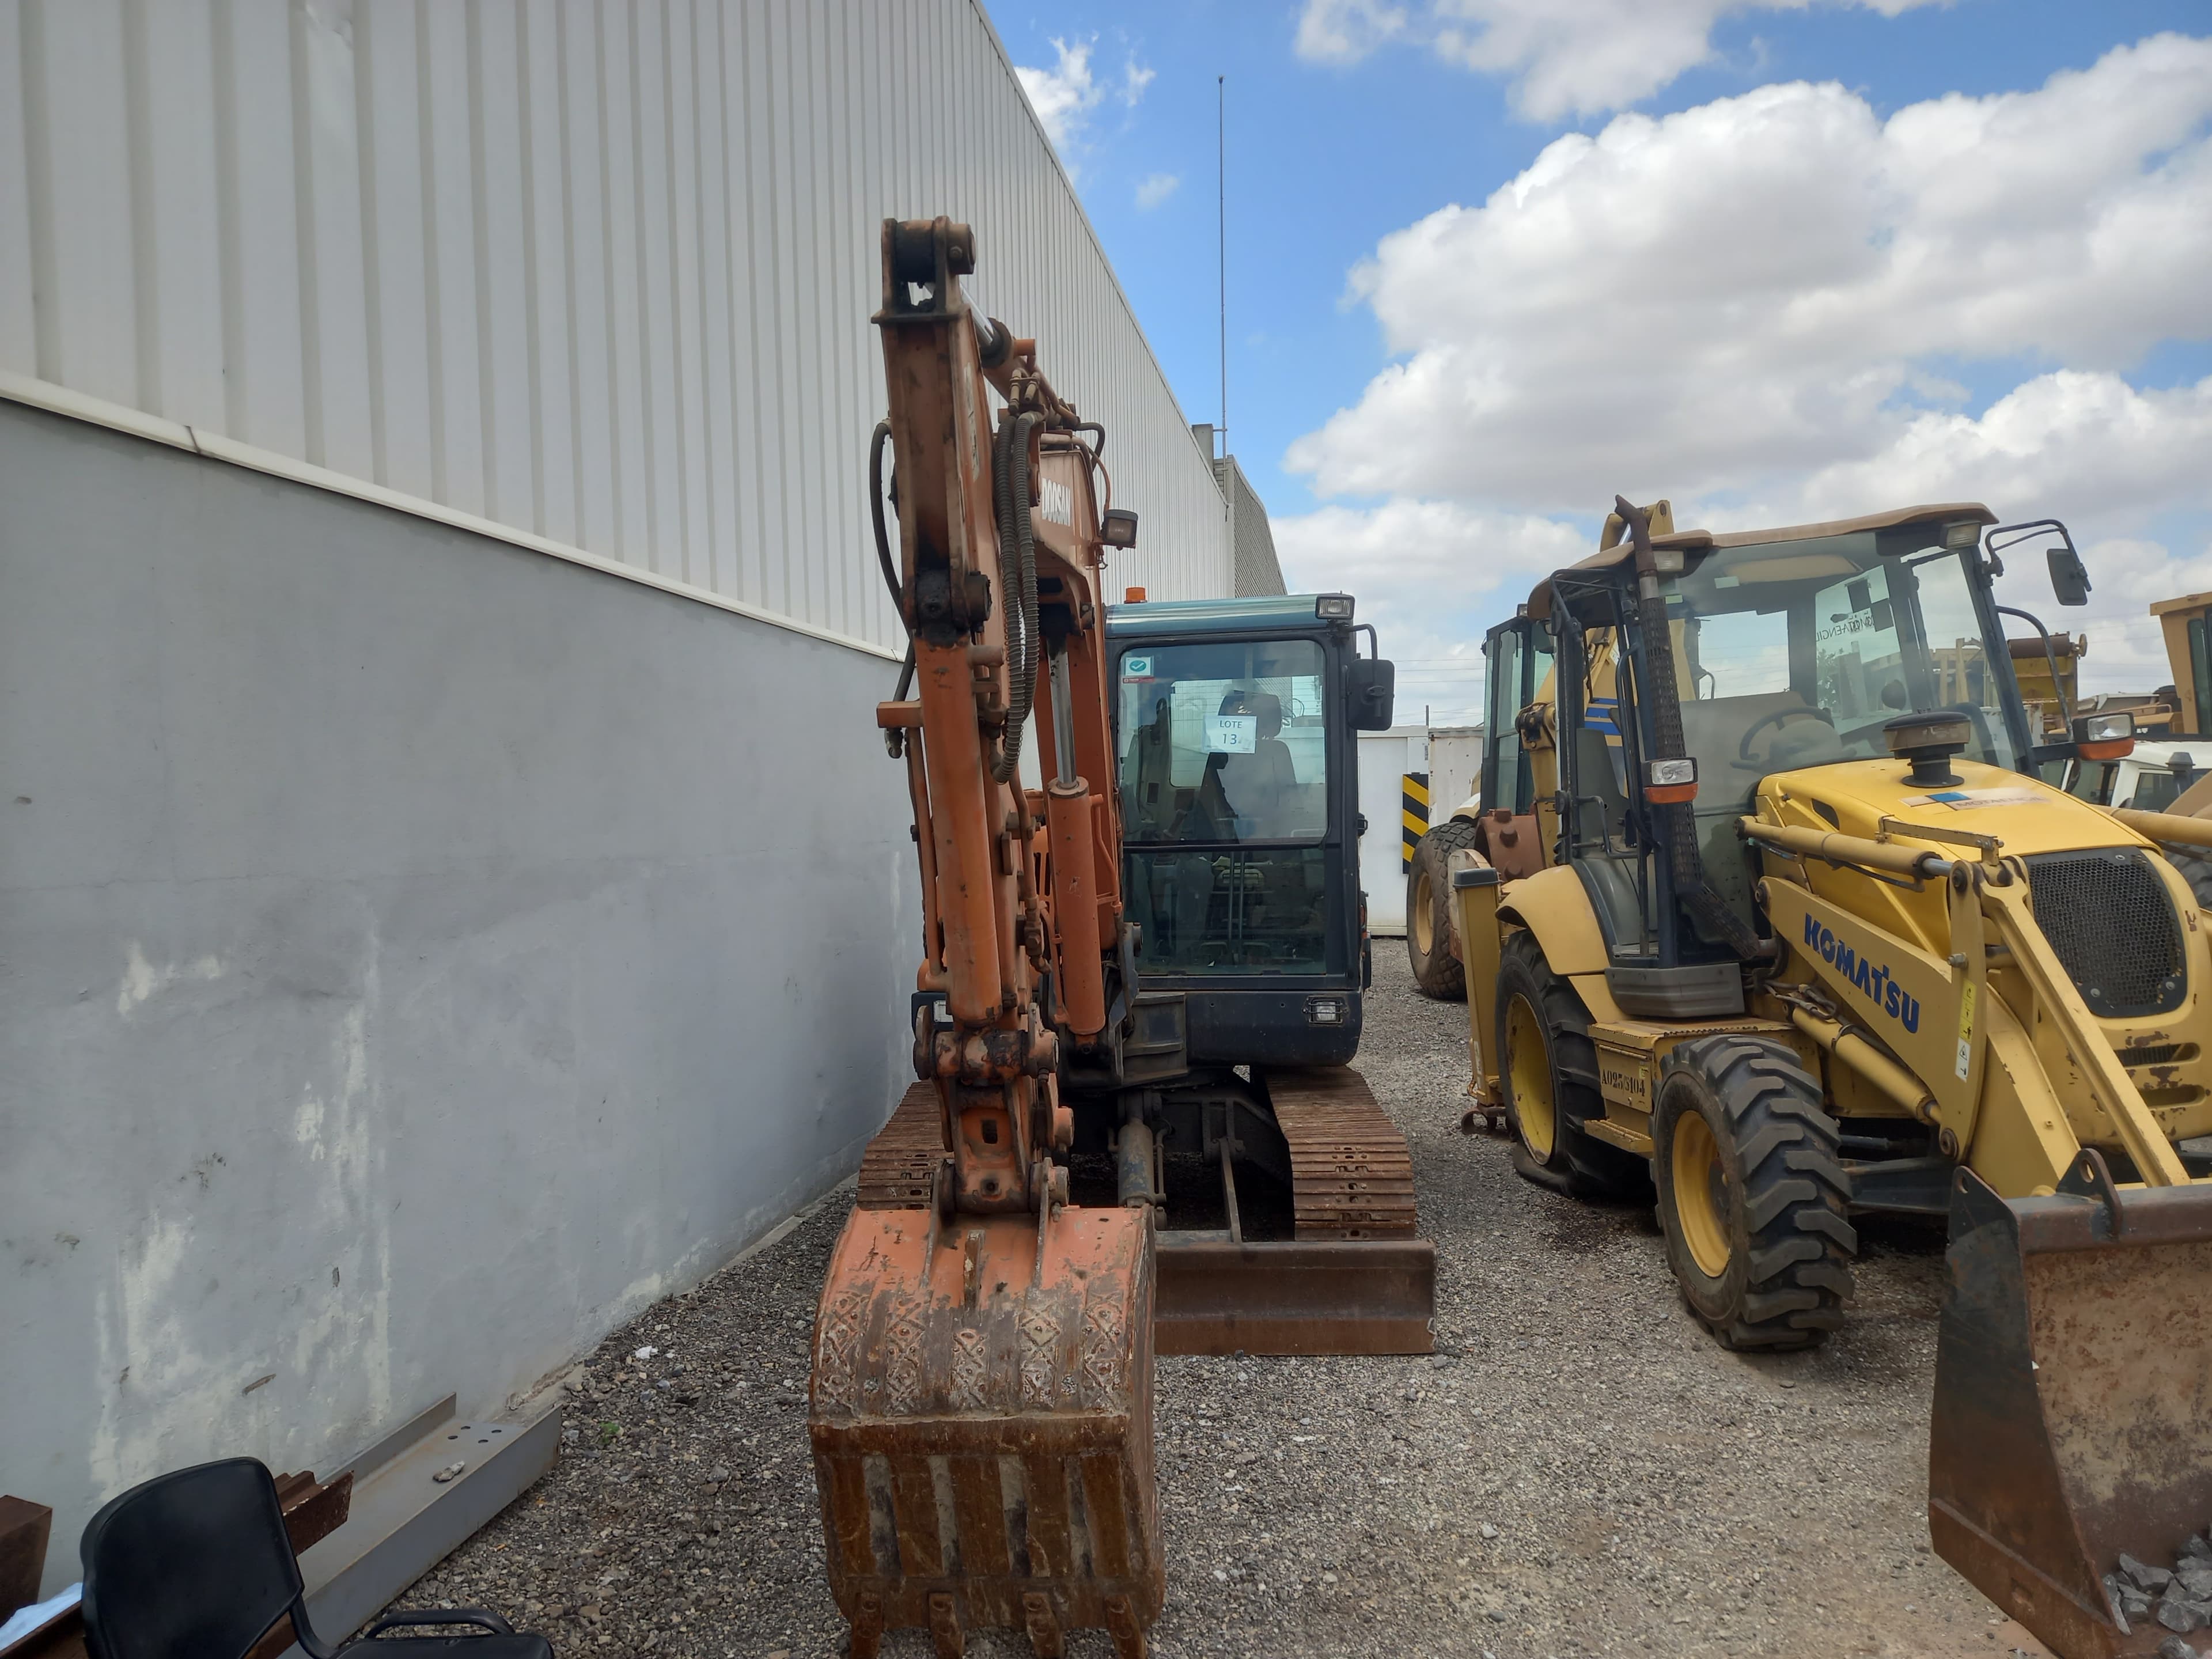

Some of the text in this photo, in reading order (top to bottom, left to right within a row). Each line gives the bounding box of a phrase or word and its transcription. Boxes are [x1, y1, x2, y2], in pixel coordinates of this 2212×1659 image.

[1042, 478, 1071, 527] DOOSAN
[1219, 720, 1243, 729] LOTE
[1222, 733, 1237, 745] 13
[1804, 912, 1920, 1034] KOMATSU
